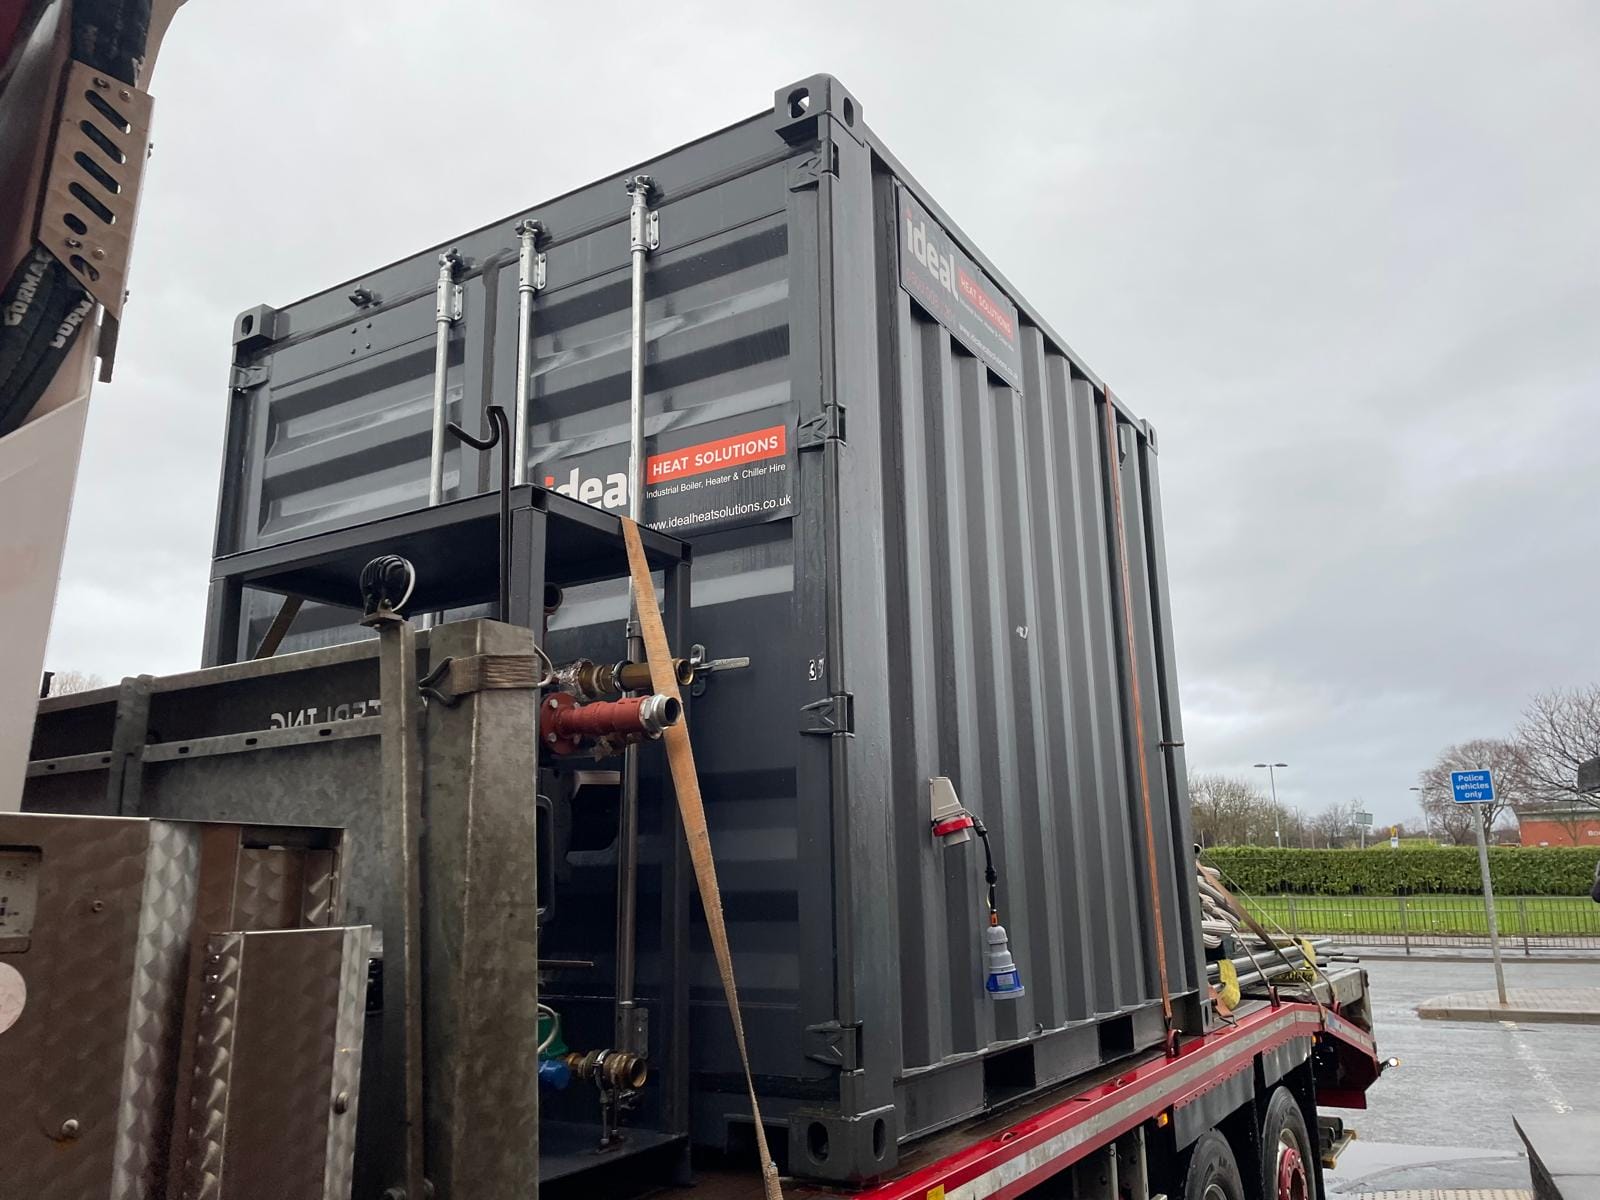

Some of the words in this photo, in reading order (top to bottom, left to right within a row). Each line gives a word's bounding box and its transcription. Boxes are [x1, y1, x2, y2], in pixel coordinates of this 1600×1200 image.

[904, 208, 960, 302] ideal
[652, 457, 689, 476] HEAT
[694, 435, 779, 467] SOLUTIONS
[544, 457, 631, 509] dea
[646, 484, 679, 499] Industrial
[680, 480, 704, 493] Boiler,
[705, 475, 731, 487] Heater
[732, 472, 739, 481] &
[741, 467, 768, 479] Chiller
[769, 463, 786, 473] Hire
[1455, 782, 1490, 790] vehicles
[1458, 774, 1484, 782] Police
[1464, 790, 1483, 799] only
